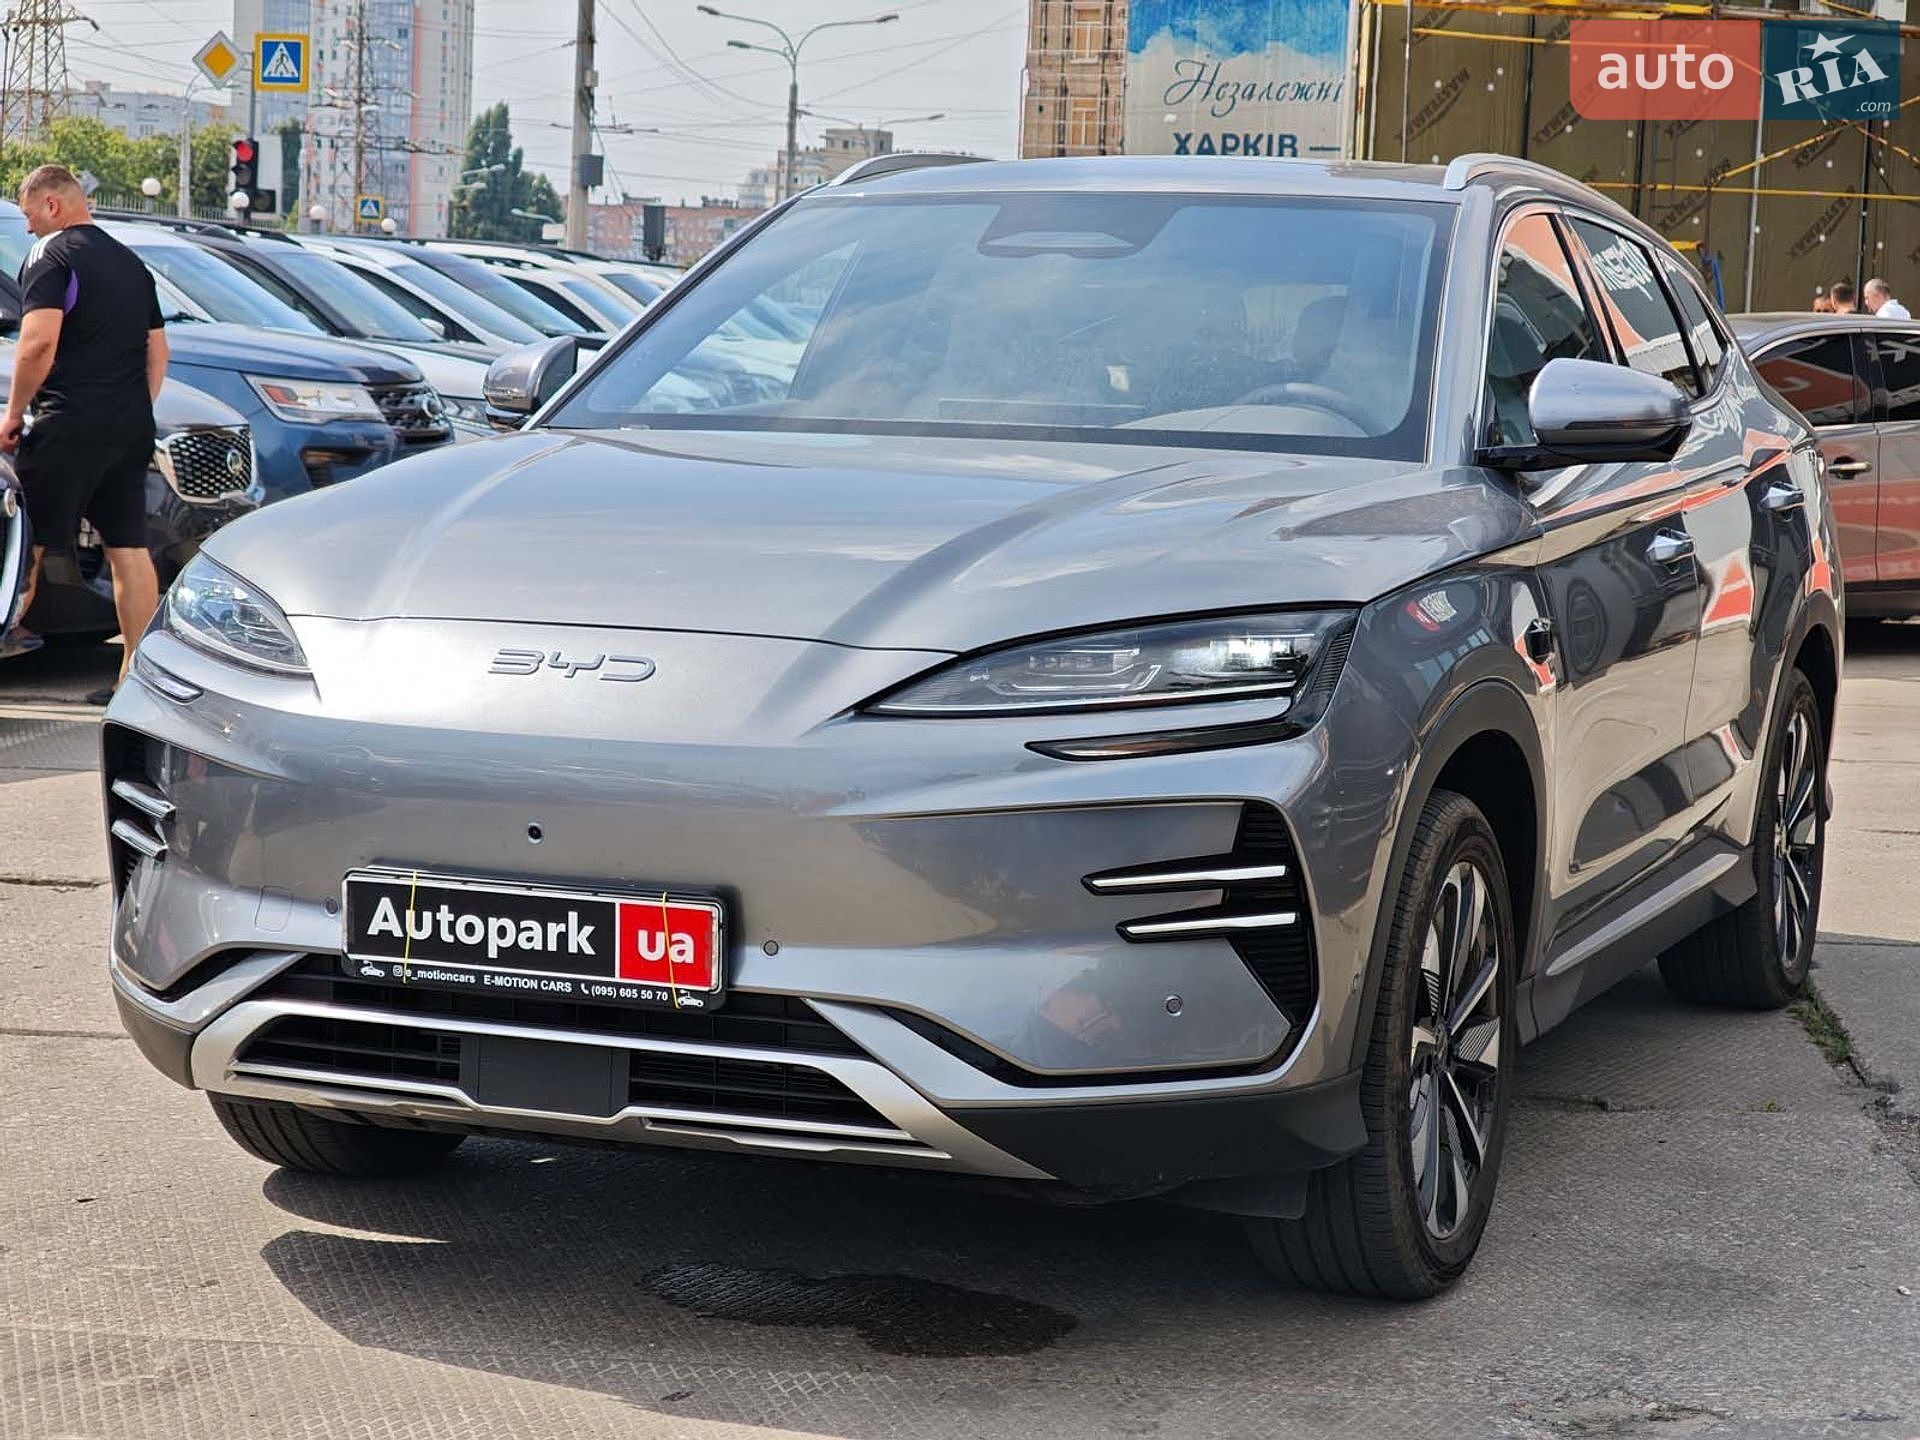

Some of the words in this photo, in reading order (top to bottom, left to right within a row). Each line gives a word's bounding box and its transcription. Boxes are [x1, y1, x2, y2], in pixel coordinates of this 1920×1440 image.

[1173, 132, 1298, 157] ХАРКІВ
[488, 649, 657, 683] BYD
[366, 896, 597, 959] Autopark
[637, 929, 695, 965] ua
[483, 974, 538, 990] E-MOTION
[540, 979, 573, 993] CARS
[591, 985, 617, 998] (095)
[619, 987, 638, 999] 605
[640, 989, 653, 1000] 50
[656, 991, 669, 1001] 70
